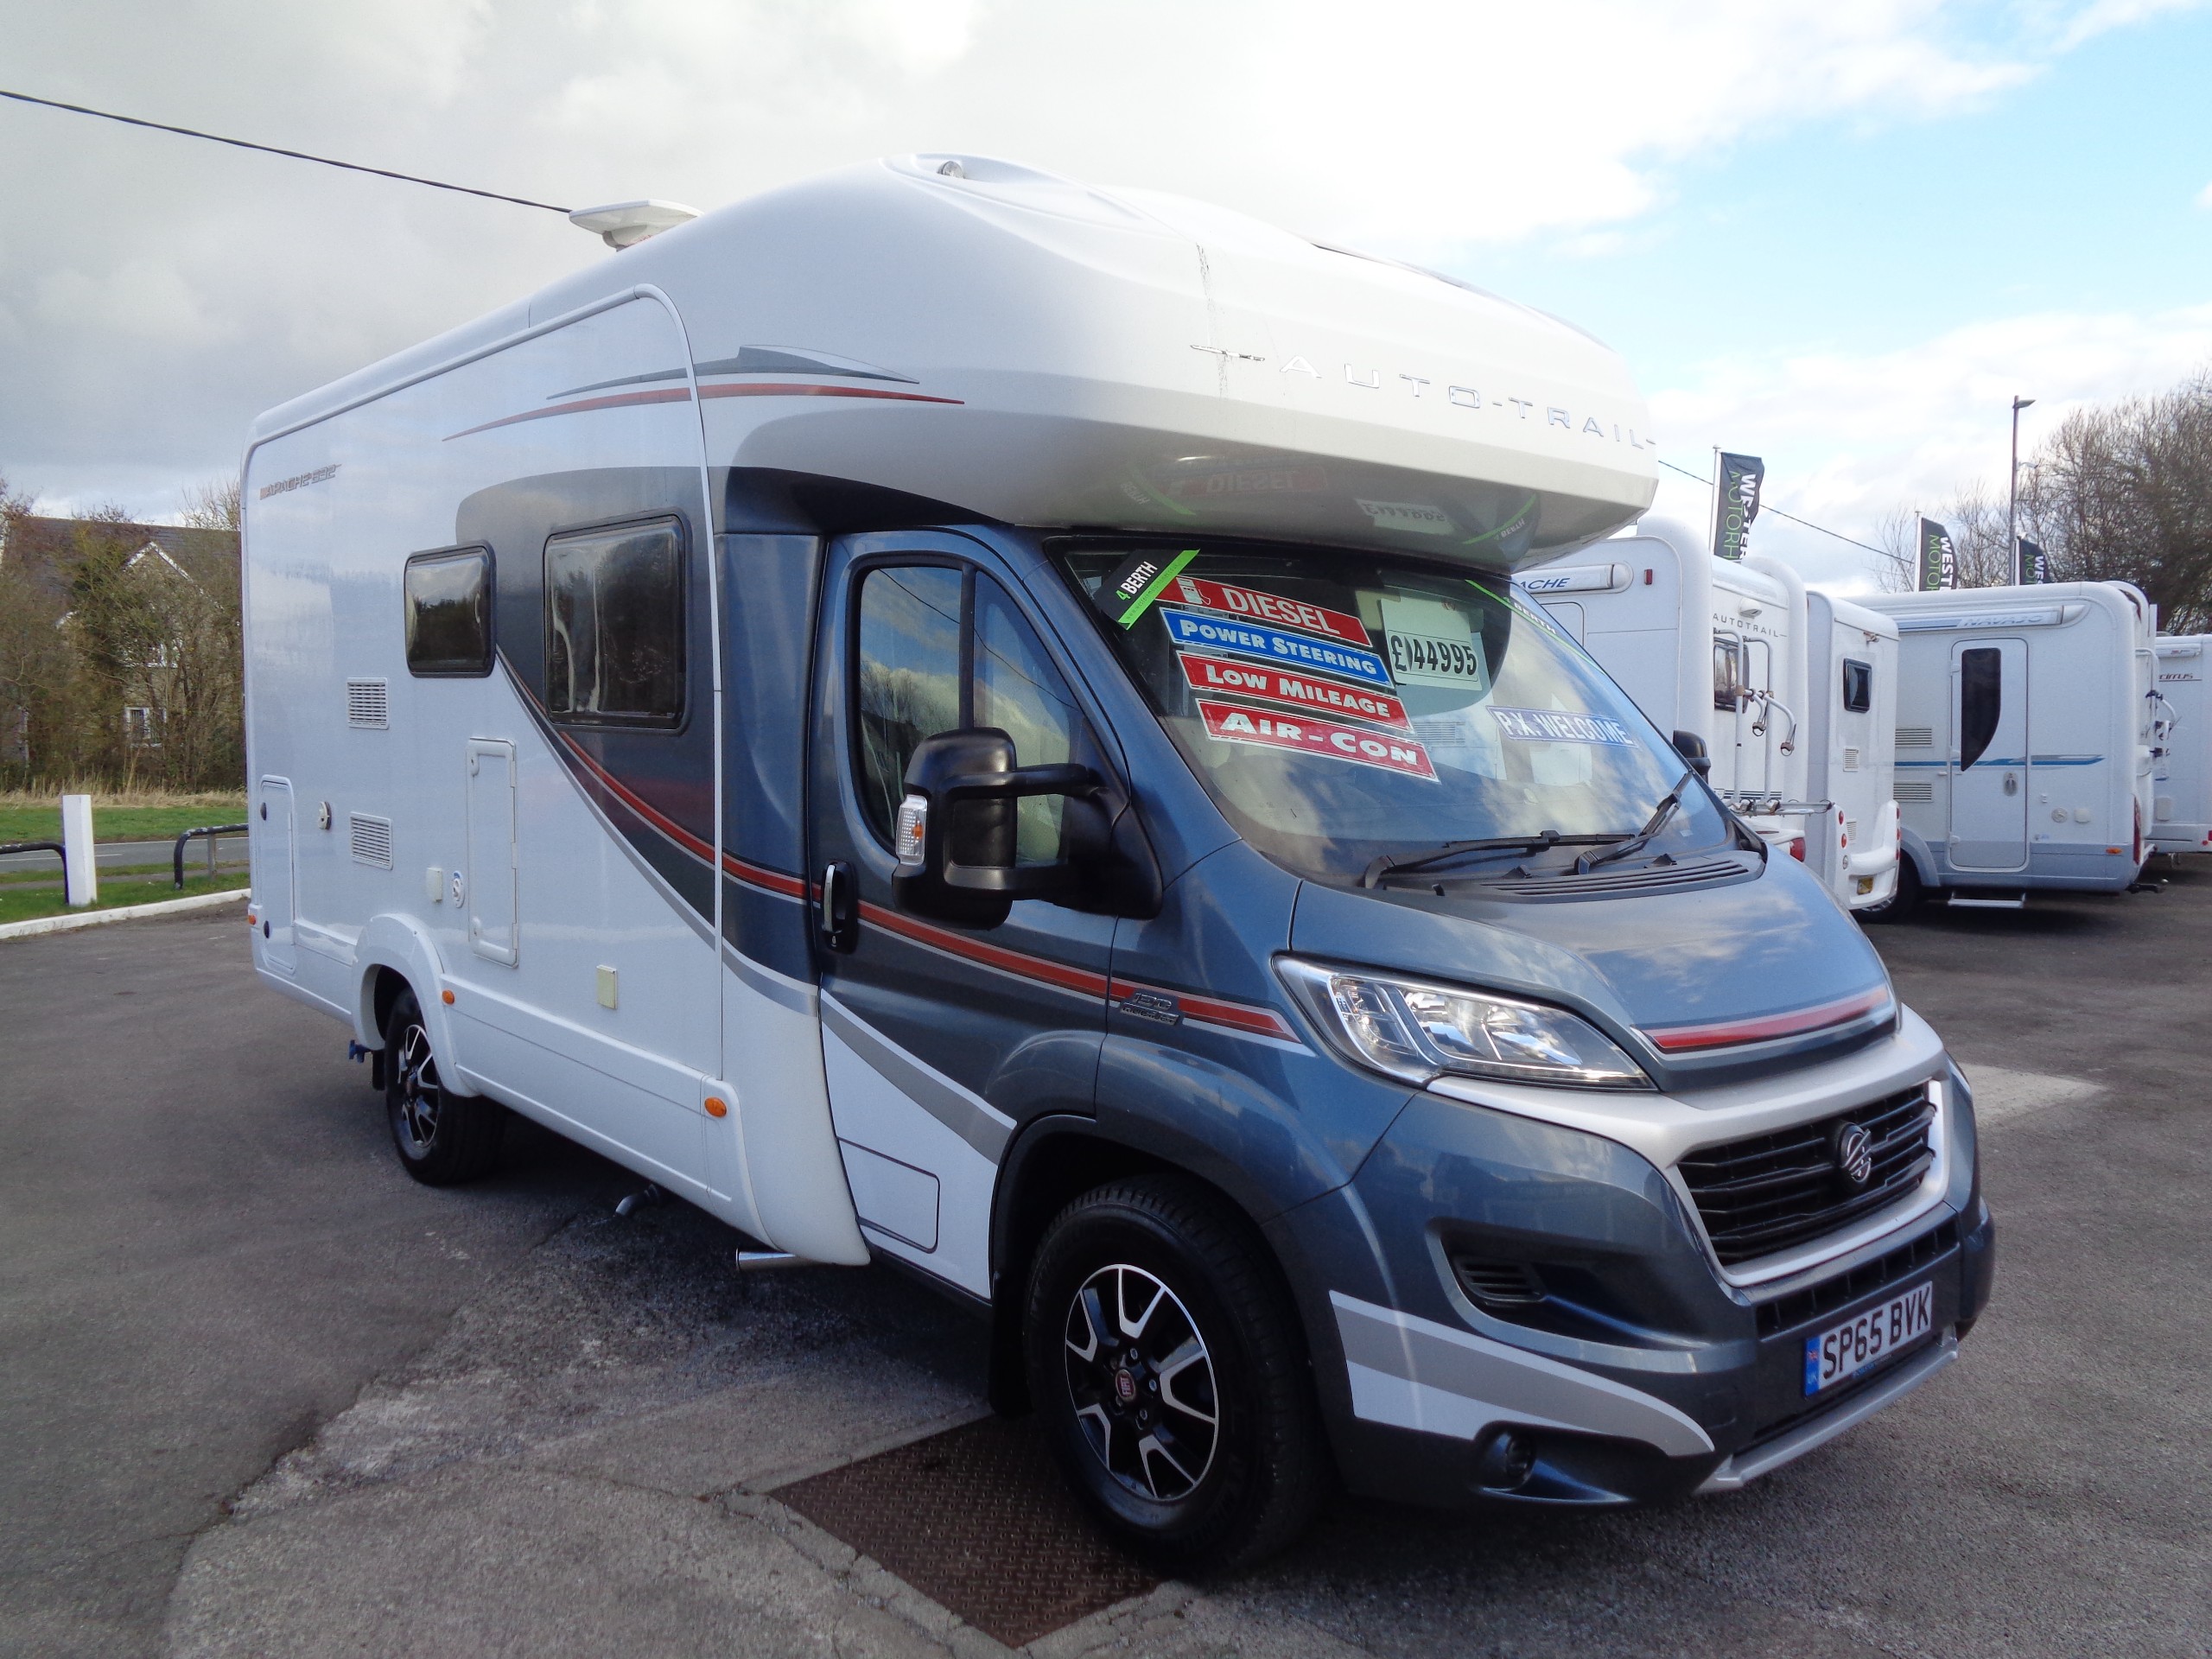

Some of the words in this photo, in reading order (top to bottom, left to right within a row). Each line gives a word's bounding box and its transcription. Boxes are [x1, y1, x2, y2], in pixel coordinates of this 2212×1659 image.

[1116, 590, 1131, 601] 4
[1120, 561, 1158, 594] BERTH
[1222, 588, 1341, 634] DIESEL
[1514, 602, 1556, 635] BERTH
[1713, 613, 1778, 638] AUTOTRAIL
[1179, 620, 1267, 649] POWER
[1272, 637, 1377, 675] STEERING
[1205, 664, 1268, 690] LOW
[1279, 677, 1390, 718] MILEAGE
[1220, 712, 1417, 766] AIR-CON
[1533, 714, 1634, 744] WELCOME
[1823, 1309, 1883, 1379] SP65
[1890, 1286, 1930, 1345] BVK
